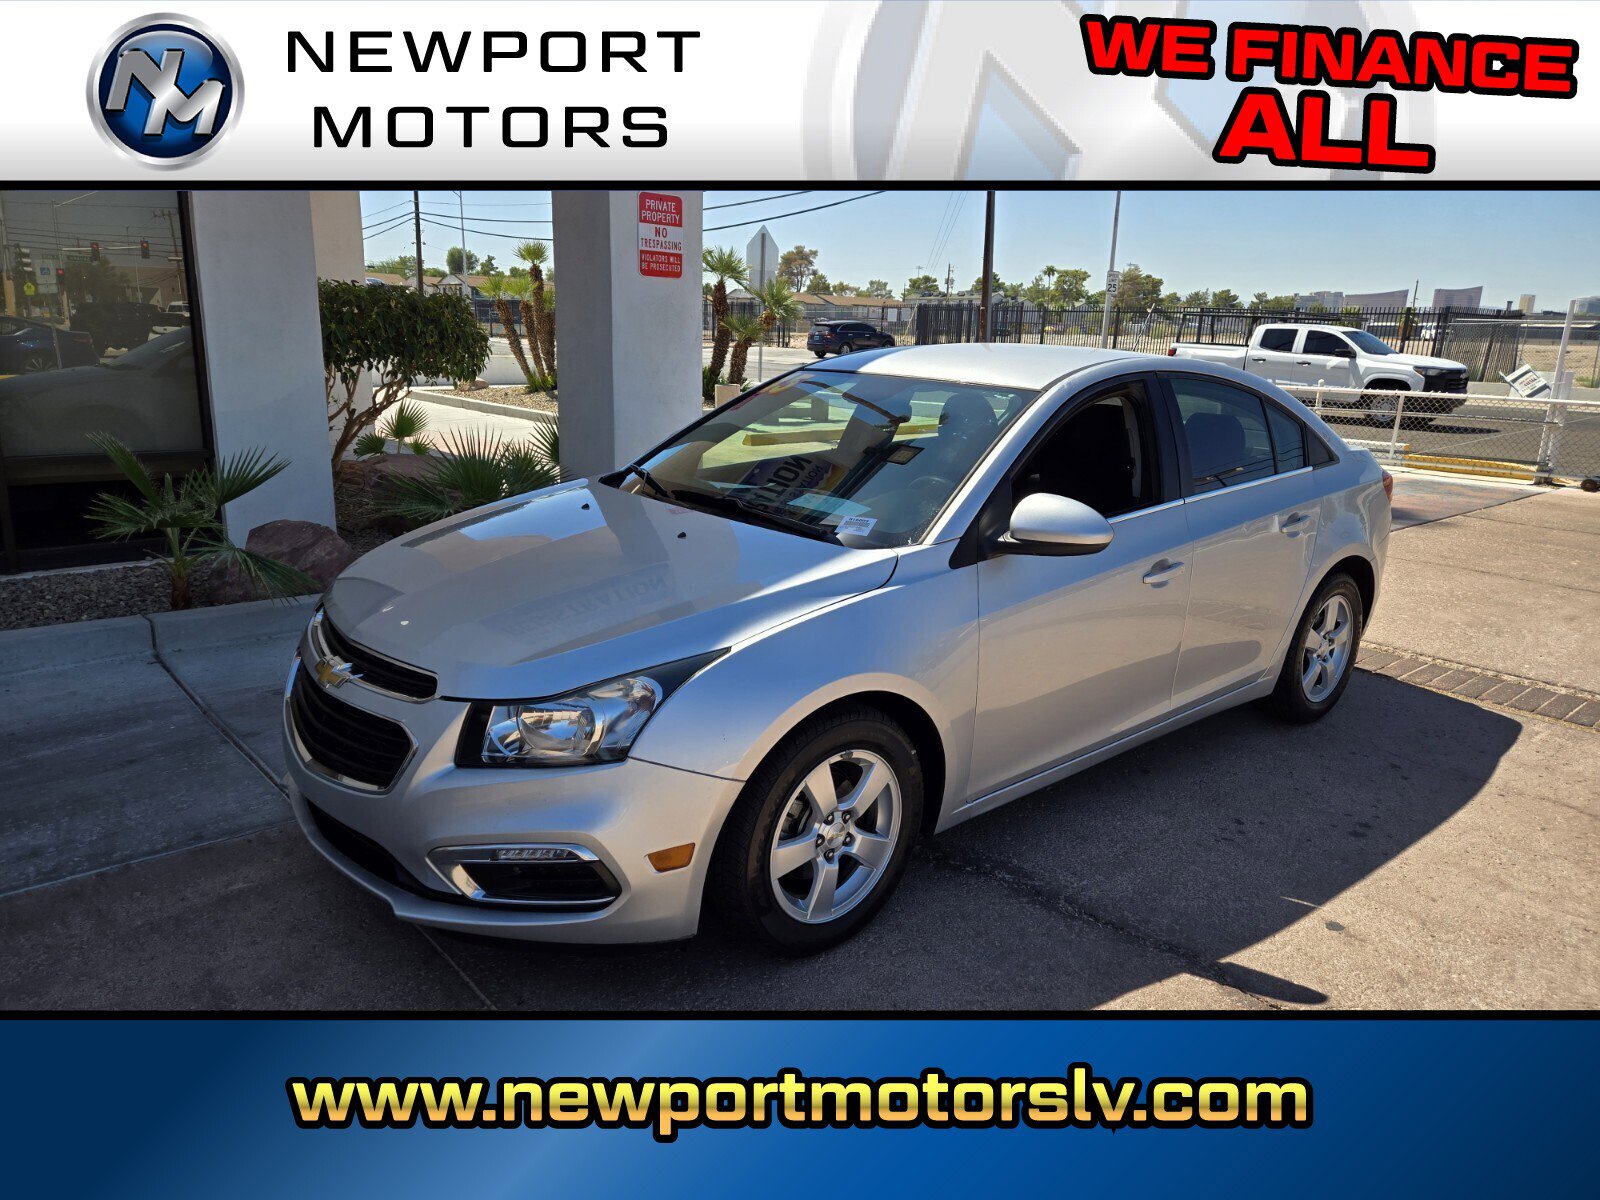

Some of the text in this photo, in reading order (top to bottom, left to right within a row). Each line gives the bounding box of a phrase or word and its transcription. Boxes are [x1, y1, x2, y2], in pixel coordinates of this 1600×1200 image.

[645, 199, 676, 213] PRIVATE
[641, 210, 680, 224] PROPERTY
[654, 226, 668, 238] NO
[640, 238, 682, 251] TRESPASSING
[641, 253, 668, 262] VIOLATORS
[649, 263, 681, 272] PROSECUTED
[1107, 283, 1117, 293] 25
